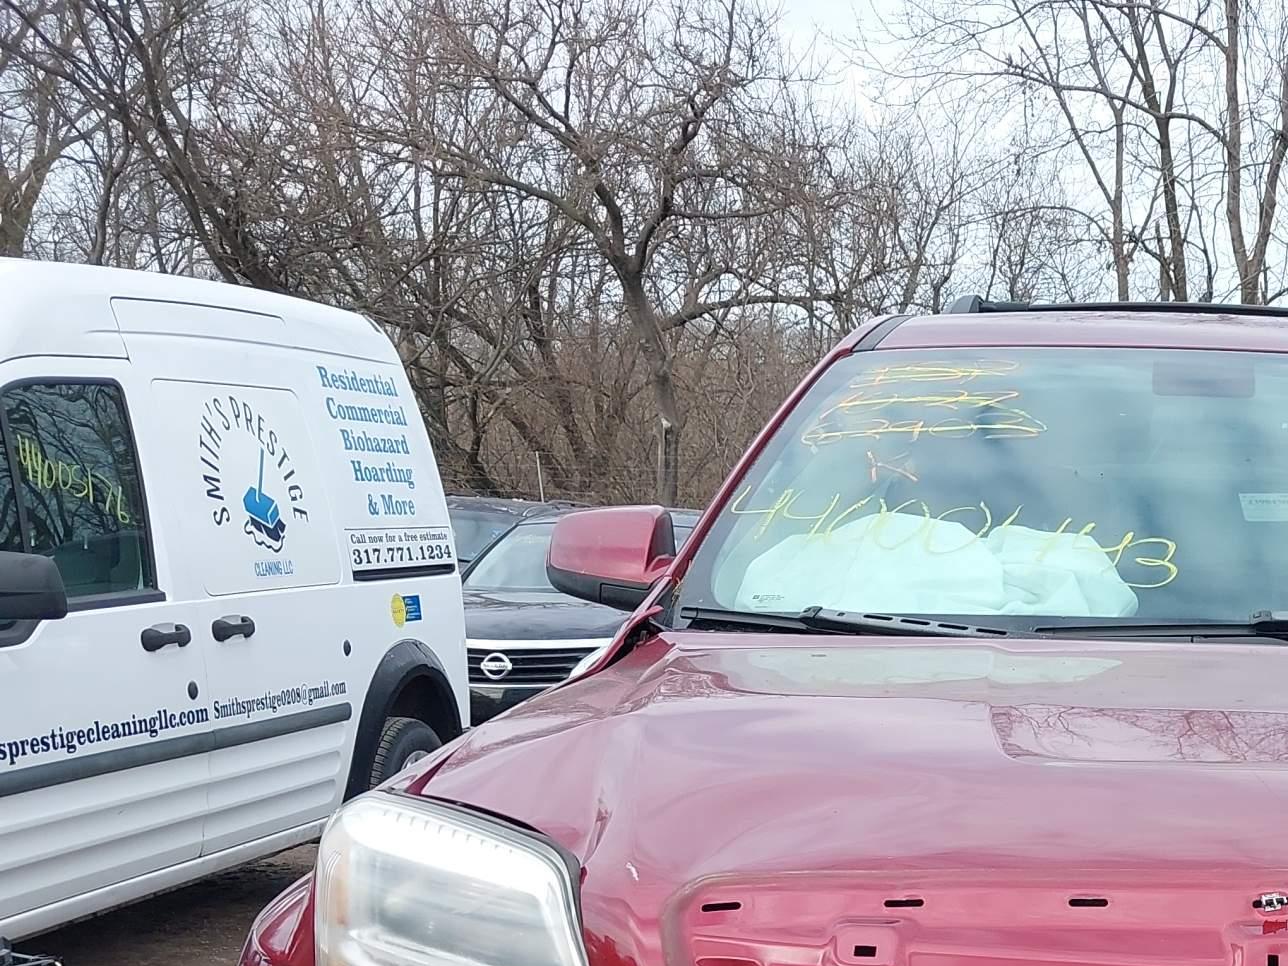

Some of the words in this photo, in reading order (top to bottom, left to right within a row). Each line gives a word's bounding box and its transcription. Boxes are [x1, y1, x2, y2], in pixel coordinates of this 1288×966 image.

[316, 366, 398, 397] Residential
[326, 397, 408, 426] Commercial
[340, 429, 410, 454] Biohazard
[17, 434, 130, 523] 44005176
[351, 460, 415, 489] Hoarding
[368, 493, 379, 515] &
[380, 494, 415, 515] More
[351, 533, 366, 544] Call
[368, 535, 383, 543] now
[385, 533, 396, 543] for
[404, 532, 418, 542] free
[419, 531, 448, 542] estimate
[352, 545, 452, 565] 317.771.1234
[254, 560, 283, 576] CLEANING
[283, 560, 293, 575] LLC
